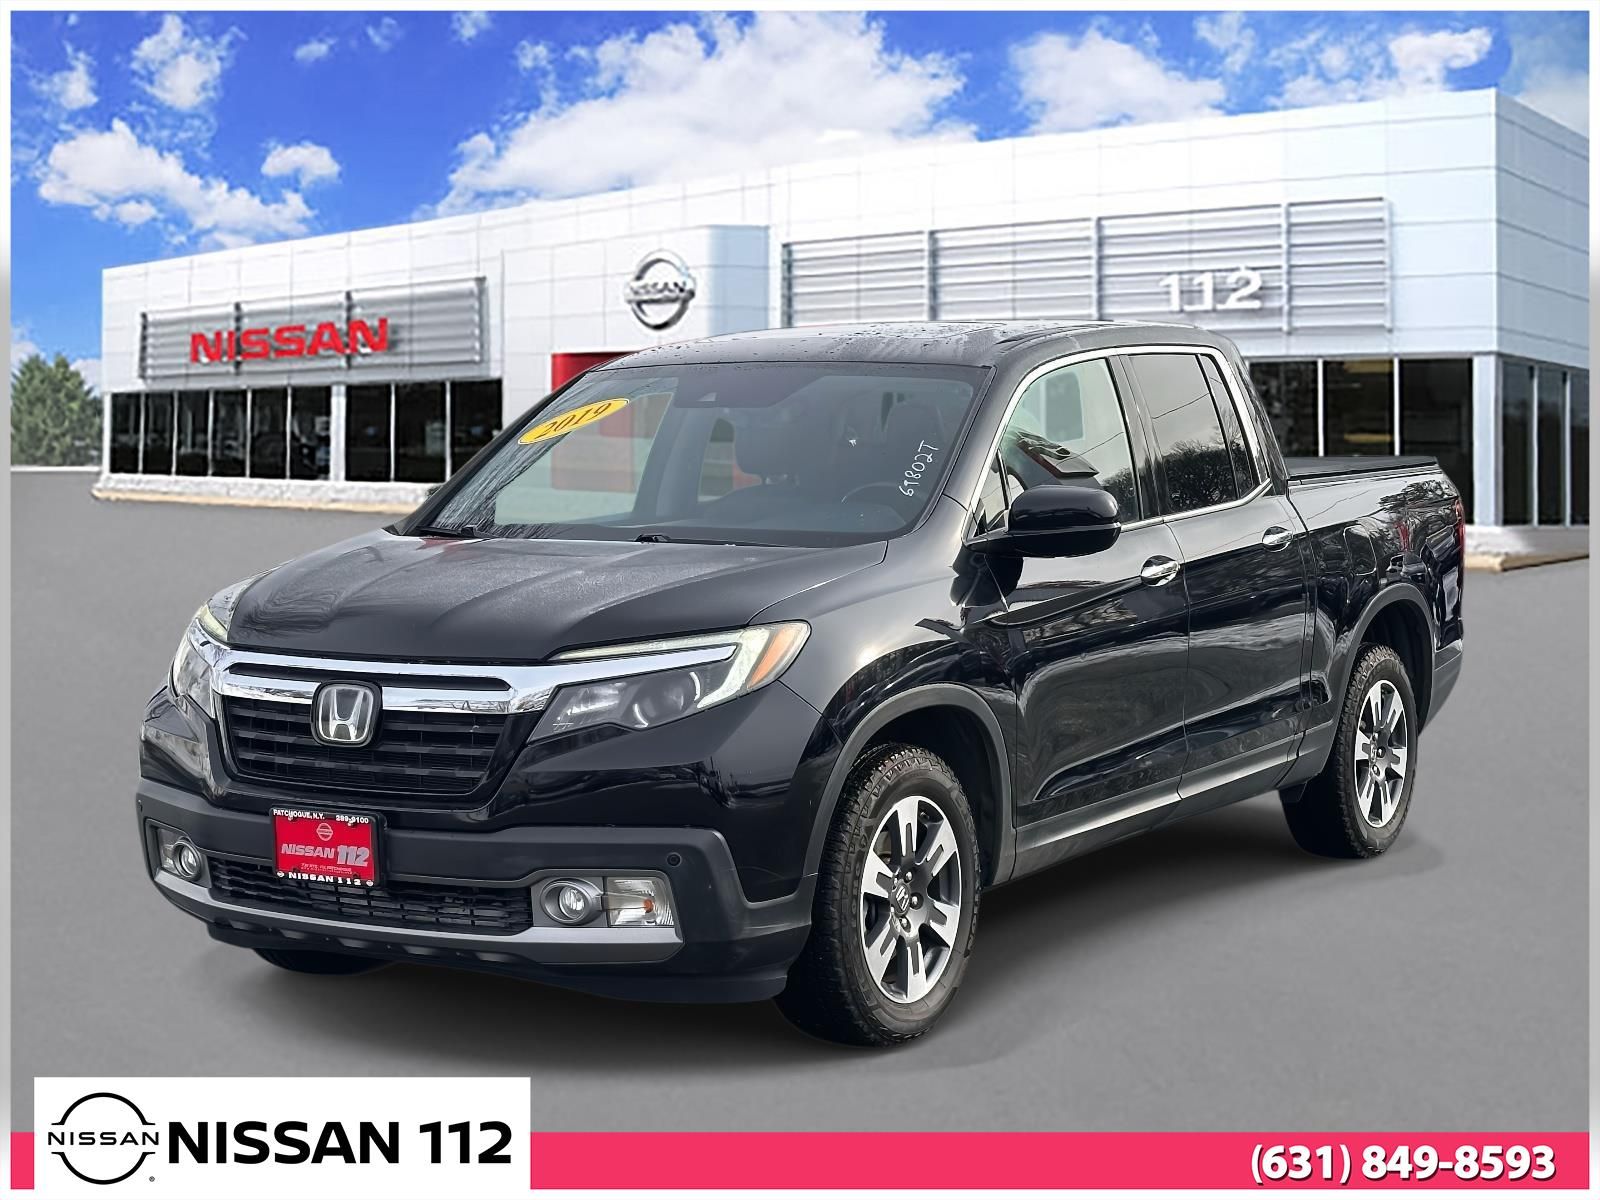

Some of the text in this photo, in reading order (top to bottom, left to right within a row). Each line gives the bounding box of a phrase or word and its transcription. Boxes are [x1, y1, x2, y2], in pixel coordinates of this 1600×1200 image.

[1158, 271, 1262, 312] 112
[190, 317, 389, 363] NISSAN
[533, 402, 612, 440] 2019
[281, 843, 370, 867] NISSAN 112
[288, 871, 334, 884] NISSAN
